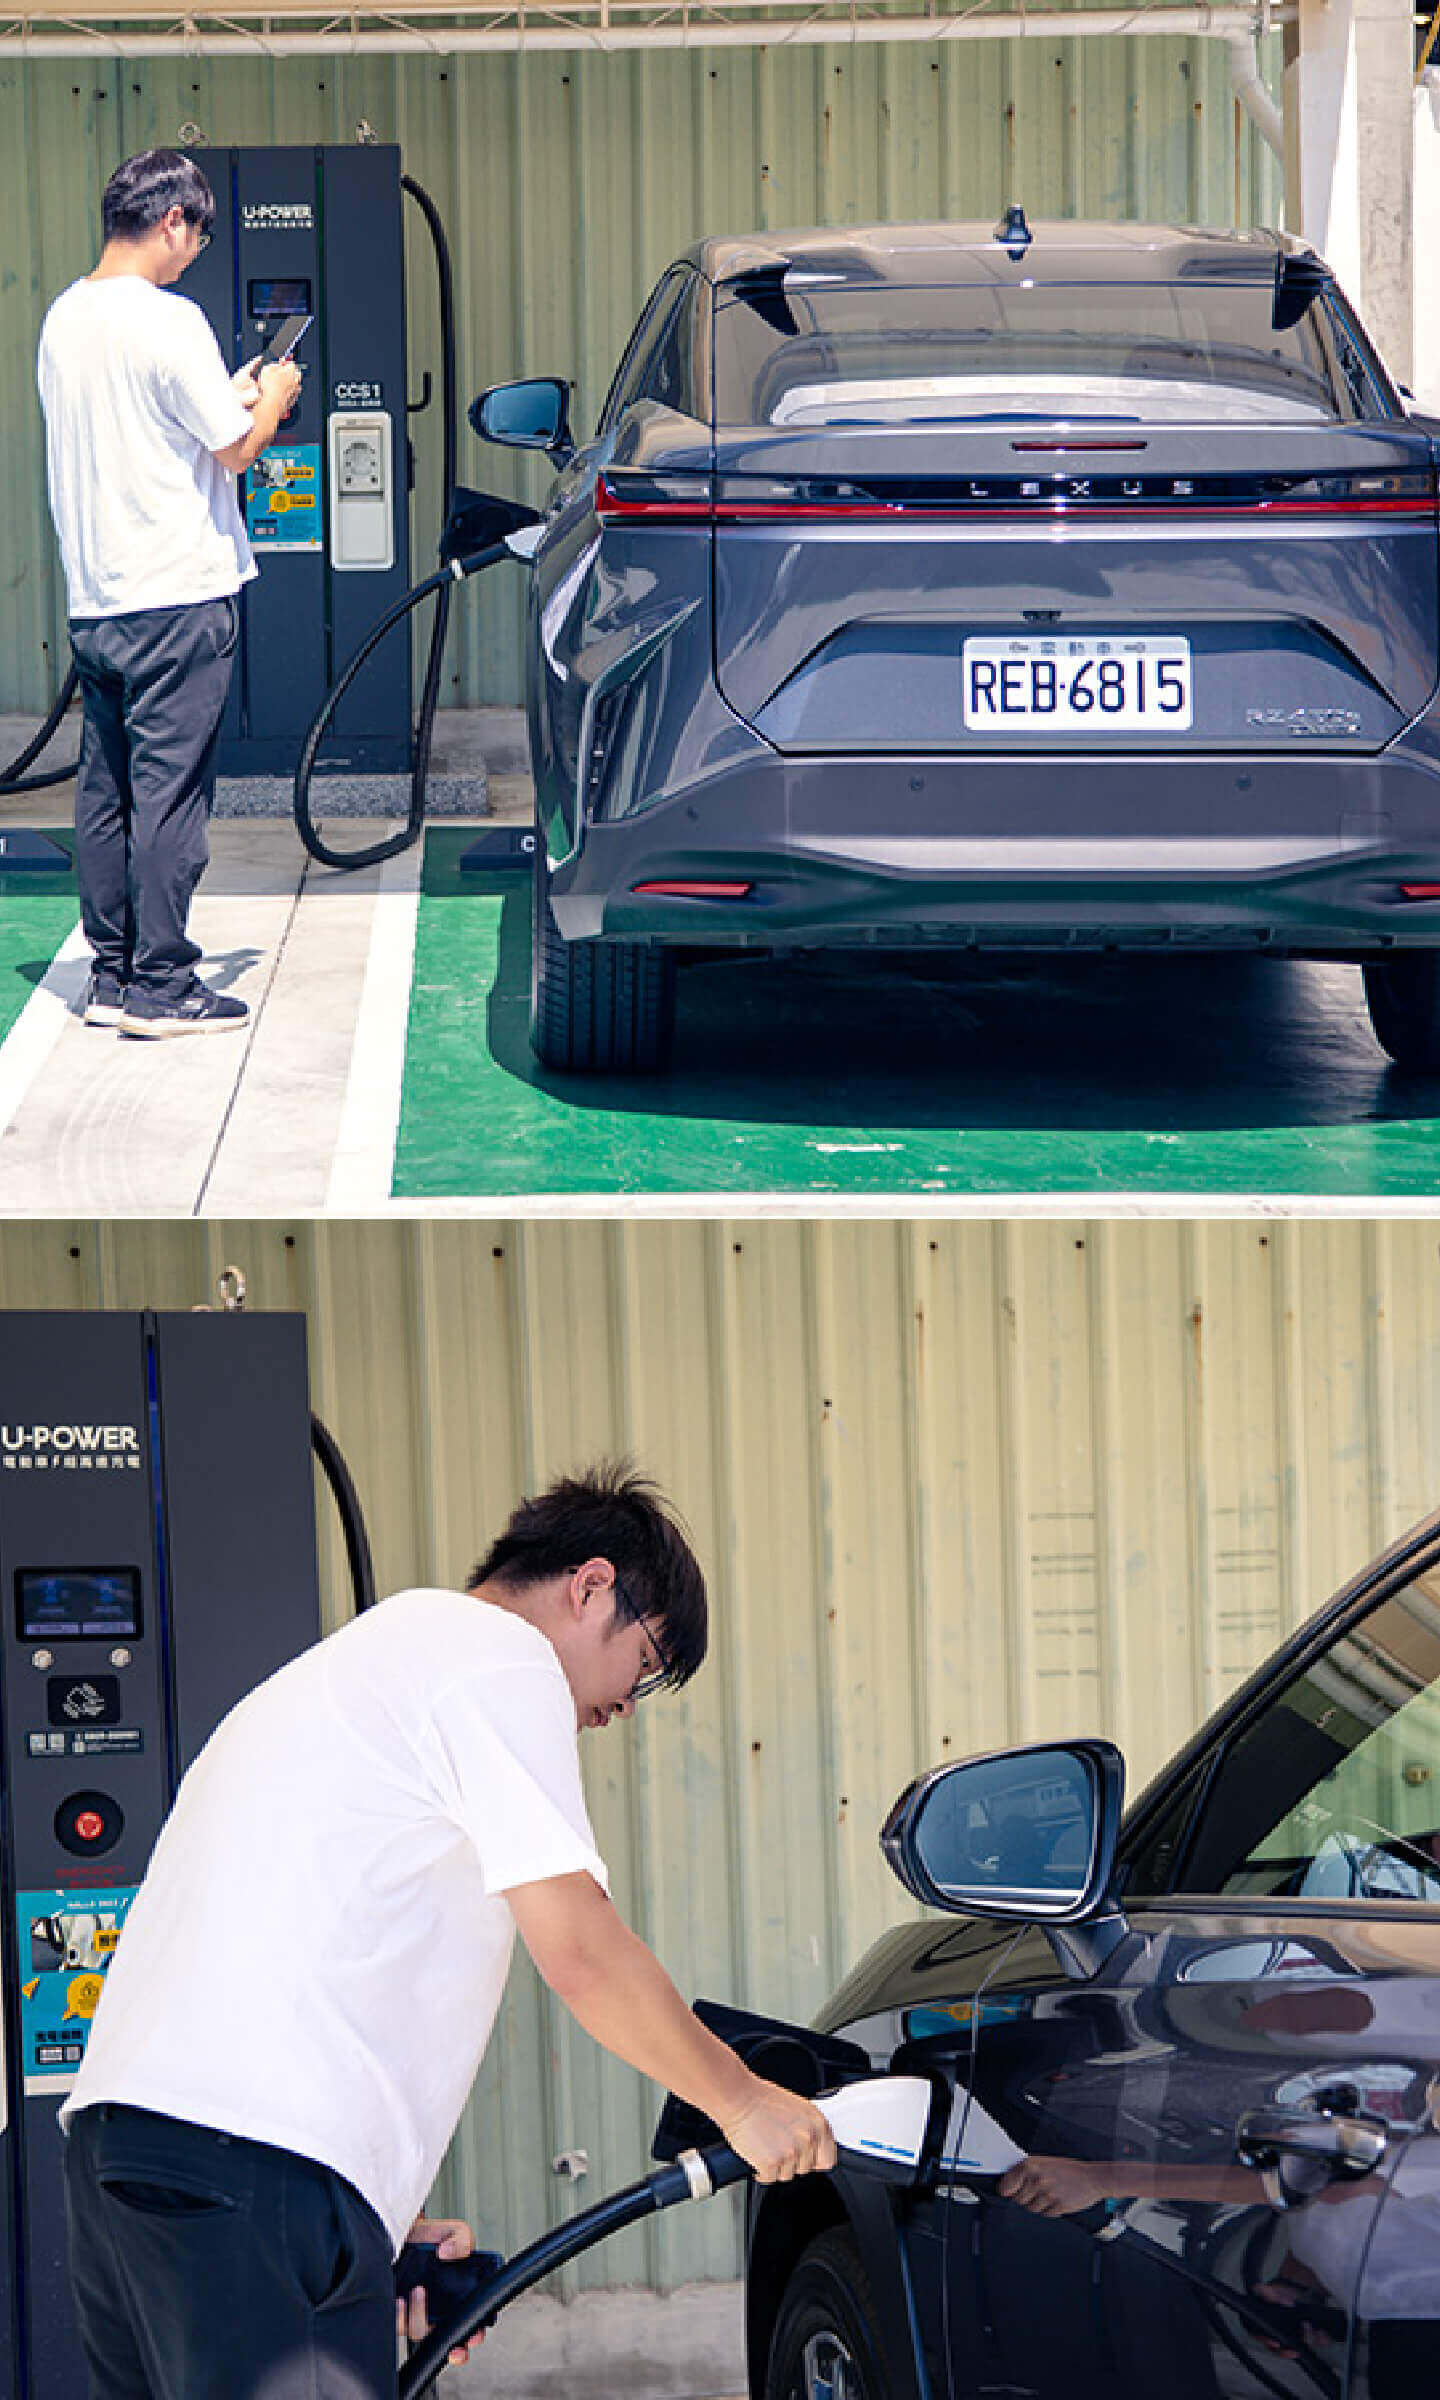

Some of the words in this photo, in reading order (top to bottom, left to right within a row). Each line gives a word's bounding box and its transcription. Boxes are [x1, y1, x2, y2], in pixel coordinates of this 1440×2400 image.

[335, 382, 381, 399] CCS1
[969, 479, 1194, 497] LEXUS
[1, 1425, 141, 1451] U-POWER
